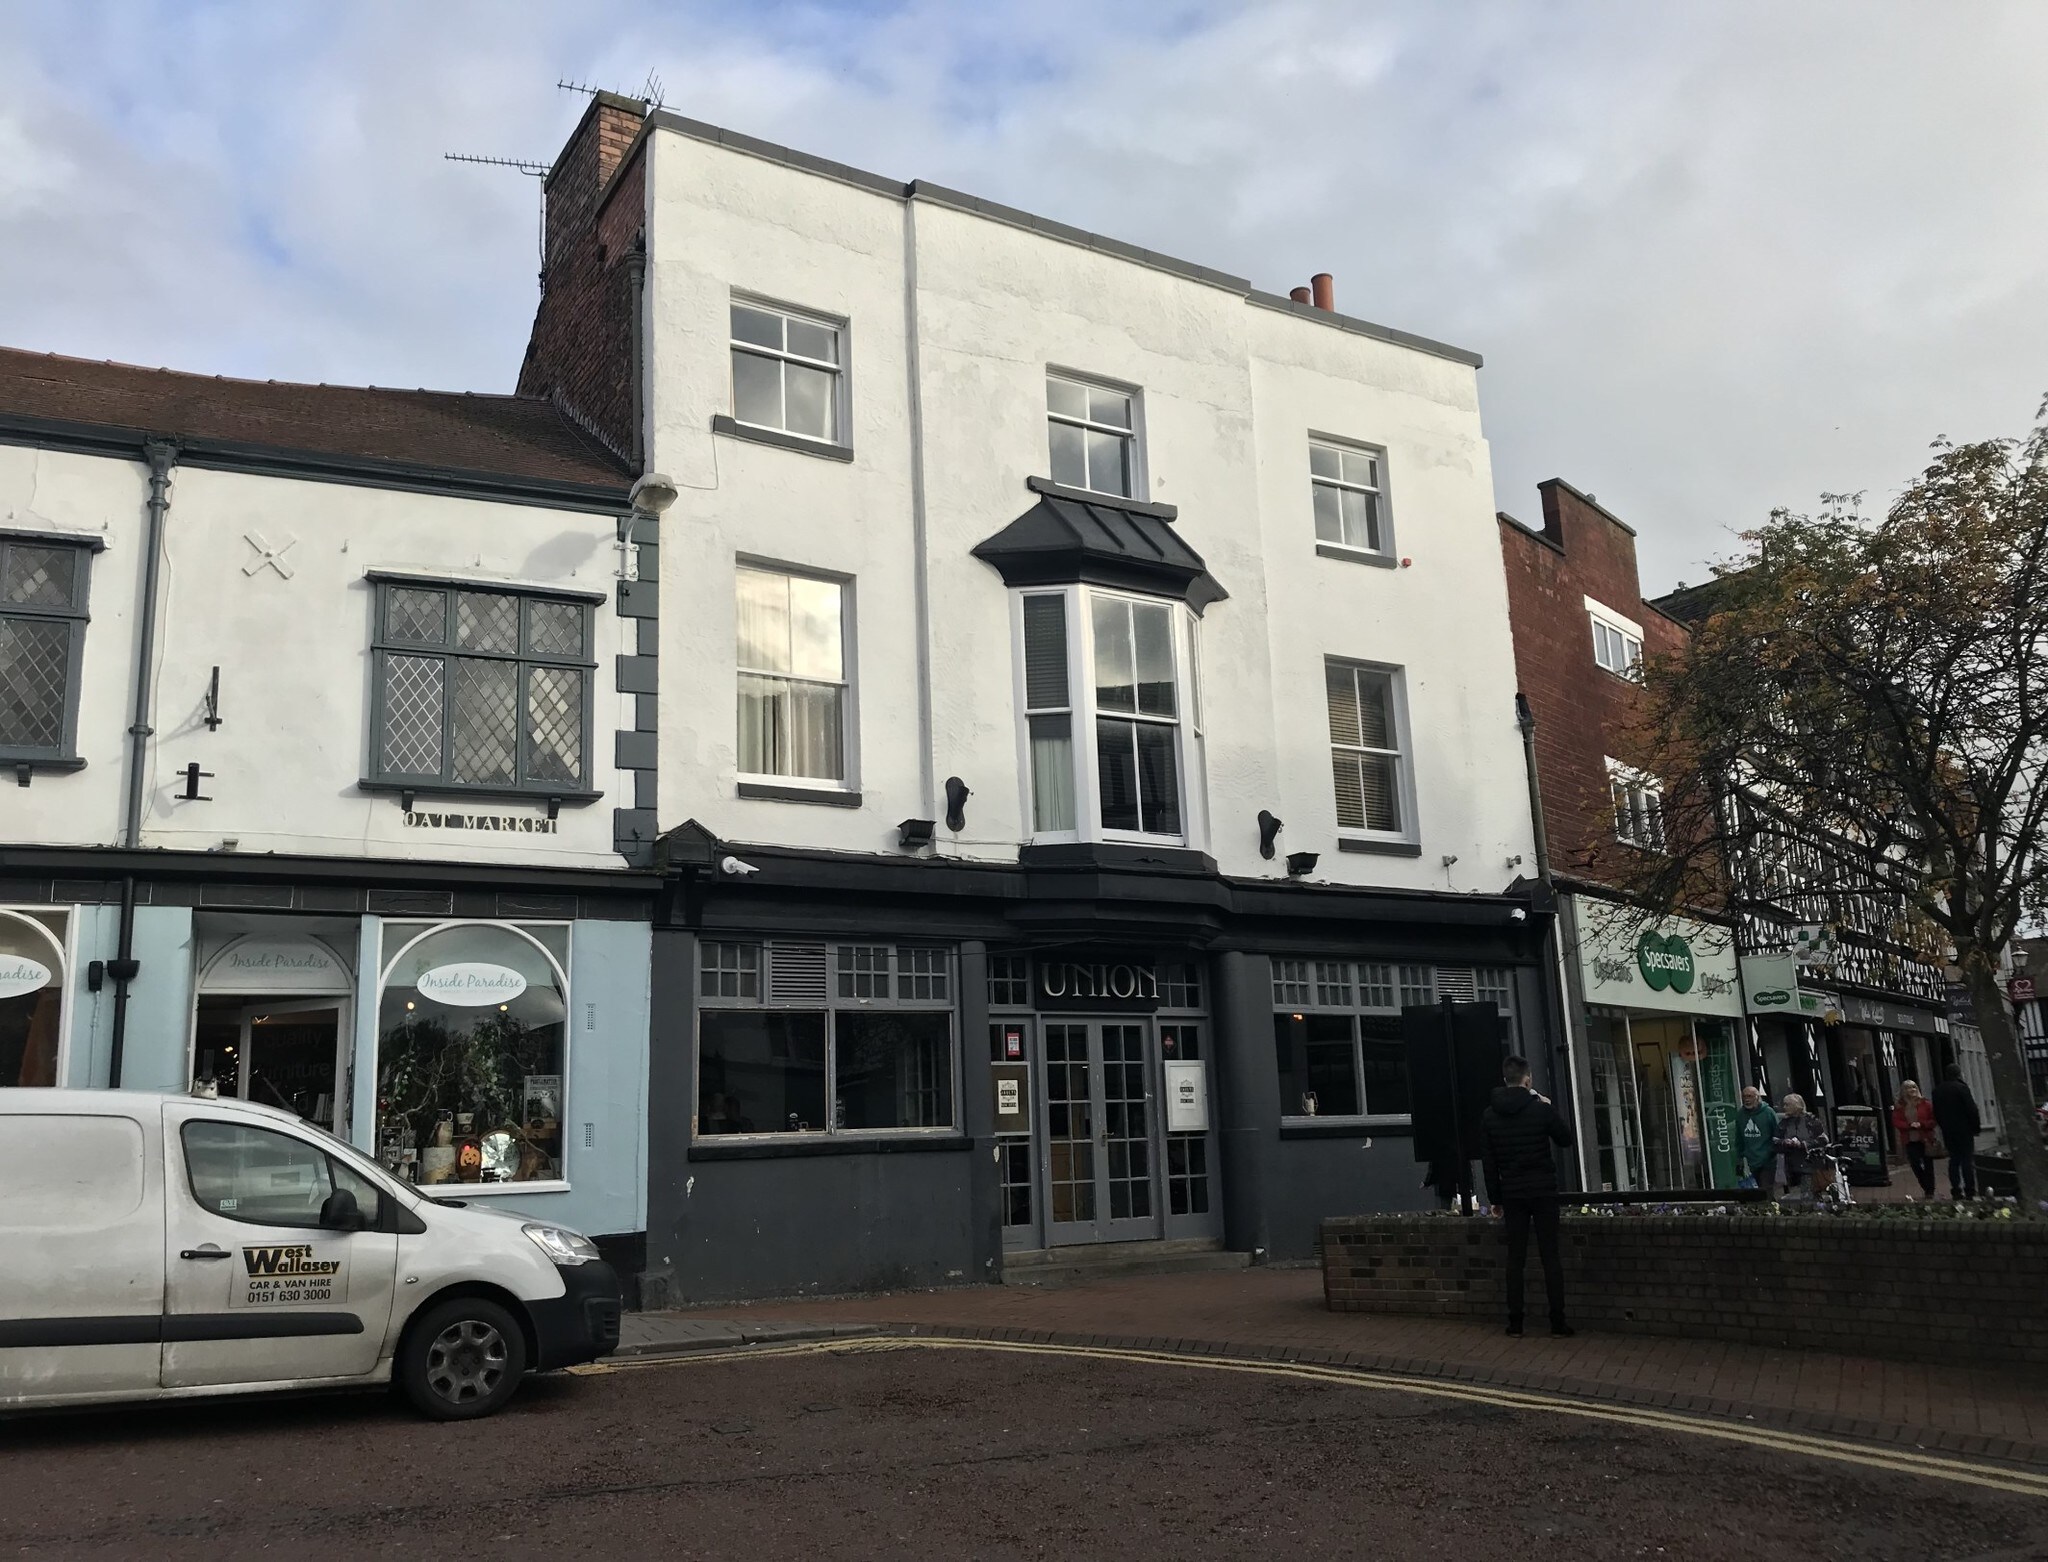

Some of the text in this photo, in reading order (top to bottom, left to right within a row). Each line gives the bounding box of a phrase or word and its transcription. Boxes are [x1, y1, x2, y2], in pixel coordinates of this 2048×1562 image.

[403, 811, 558, 834] OAT MARKET
[230, 953, 330, 969] Inside Paradise
[1643, 946, 1690, 972] Specsavers
[422, 973, 521, 988] Inside Paradise
[1041, 963, 1160, 998] UNION
[1756, 994, 1788, 1003] Specsavers
[1711, 1064, 1731, 1153] Contact Lenses
[243, 1245, 312, 1274] West
[249, 1278, 332, 1290] CAR & VAN HIRE
[247, 1289, 331, 1303] 0151 630 3000
